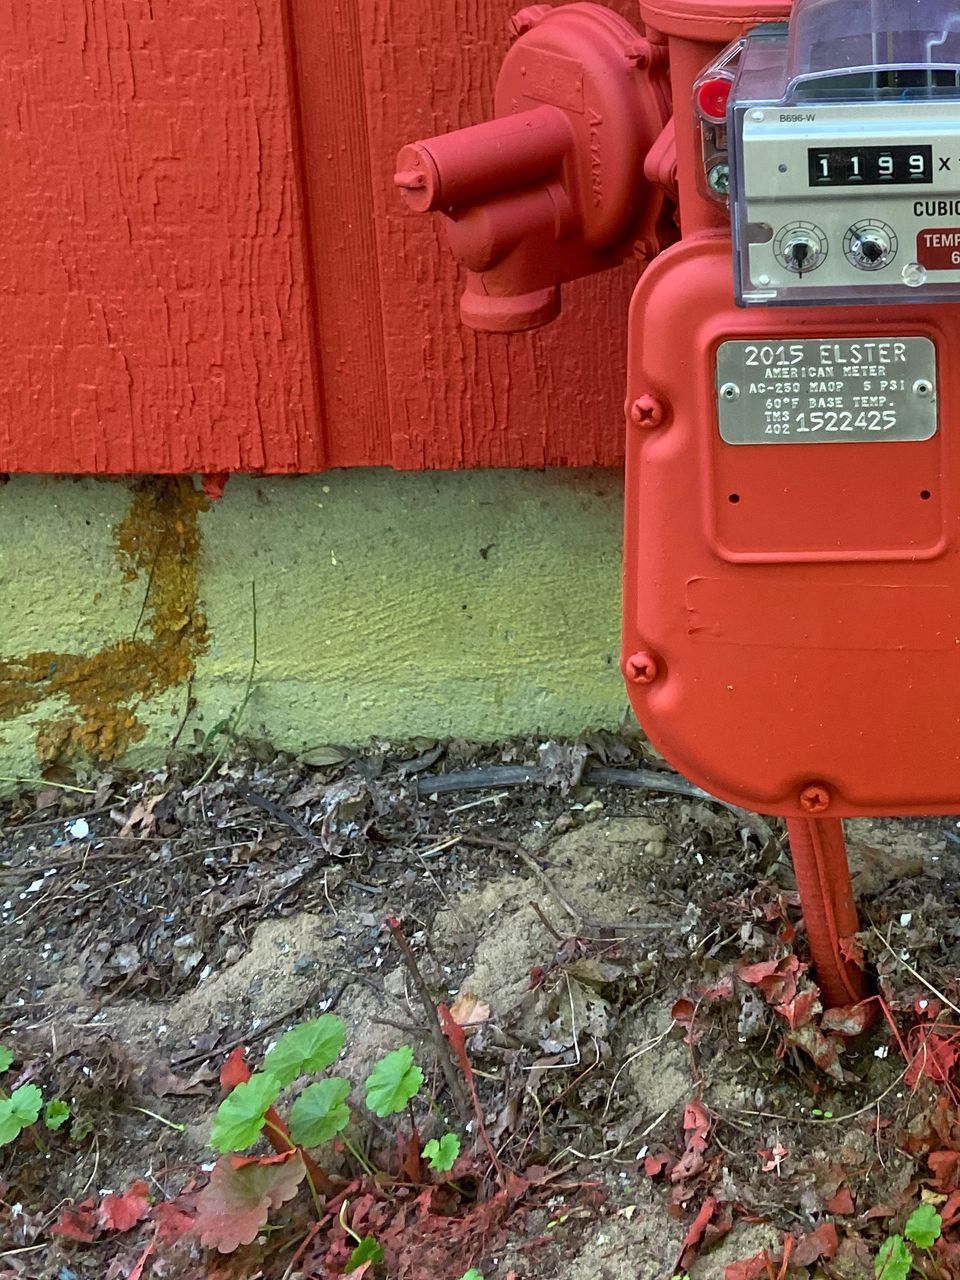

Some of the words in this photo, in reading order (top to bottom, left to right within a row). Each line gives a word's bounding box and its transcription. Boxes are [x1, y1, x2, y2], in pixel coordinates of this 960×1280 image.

[779, 114, 816, 123] B696-W
[744, 345, 804, 366] 2015
[819, 343, 907, 365] ELSTER
[764, 367, 835, 379] AMERICAN
[842, 365, 886, 377] METER
[749, 382, 801, 394] AC-250
[809, 381, 844, 393] MAOP
[863, 380, 872, 391] 5
[879, 379, 905, 391] PSI
[765, 397, 800, 409] 60°F
[808, 397, 844, 408] BASE
[852, 396, 895, 408] TEMP.
[764, 410, 790, 422] TMS
[795, 409, 897, 433] 1522425
[764, 424, 791, 435] 402
